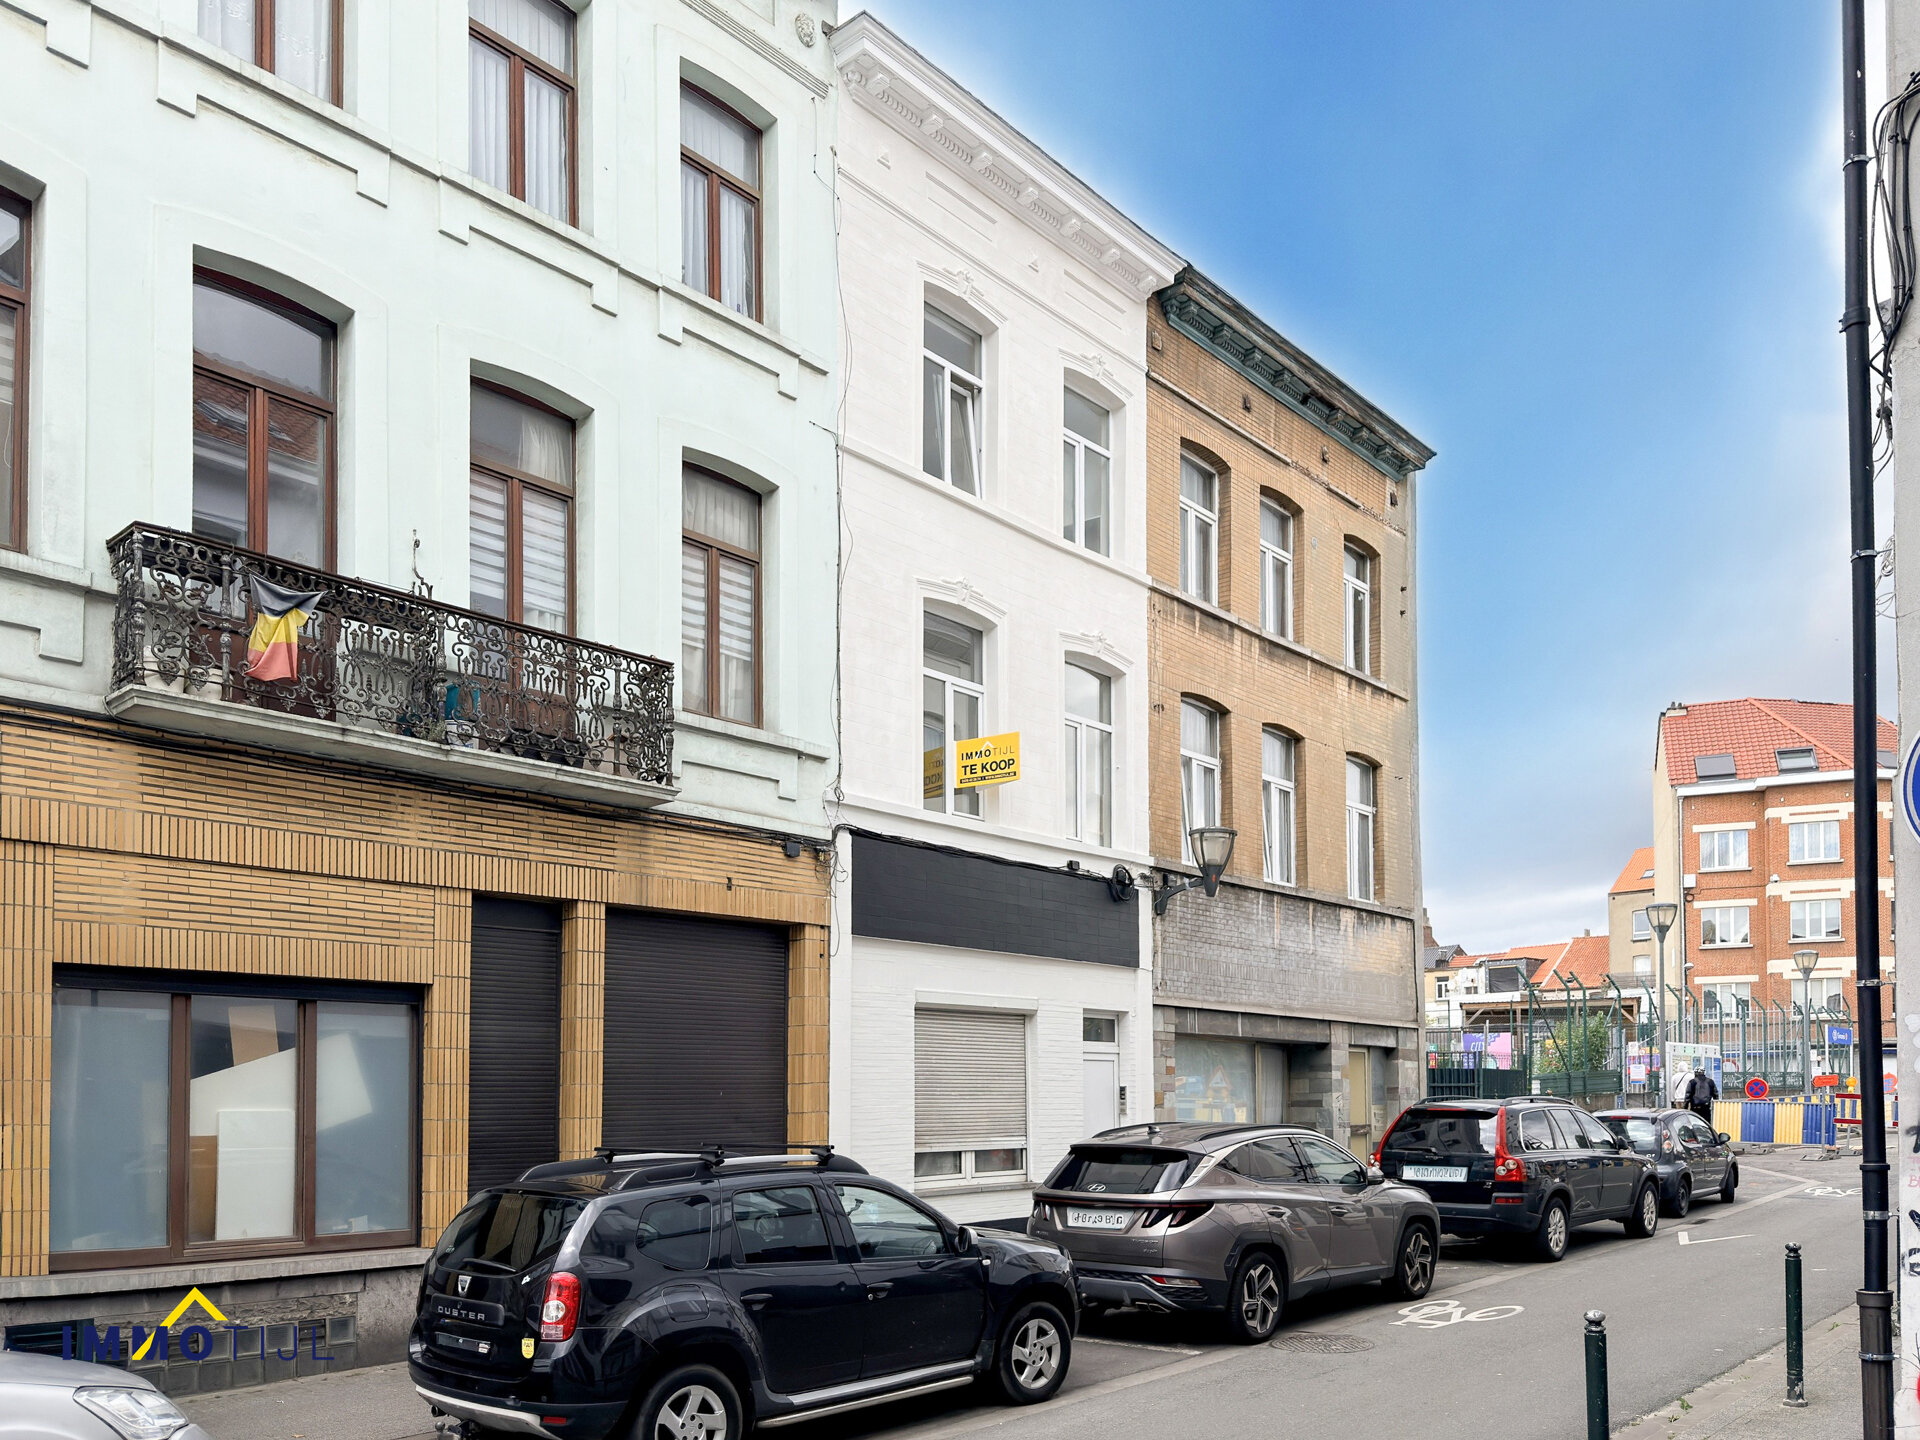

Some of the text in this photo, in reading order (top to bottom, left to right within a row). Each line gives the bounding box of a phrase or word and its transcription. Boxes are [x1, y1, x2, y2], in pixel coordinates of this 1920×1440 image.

[961, 758, 1015, 776] TE KOOP
[437, 1306, 485, 1321] DUSTER
